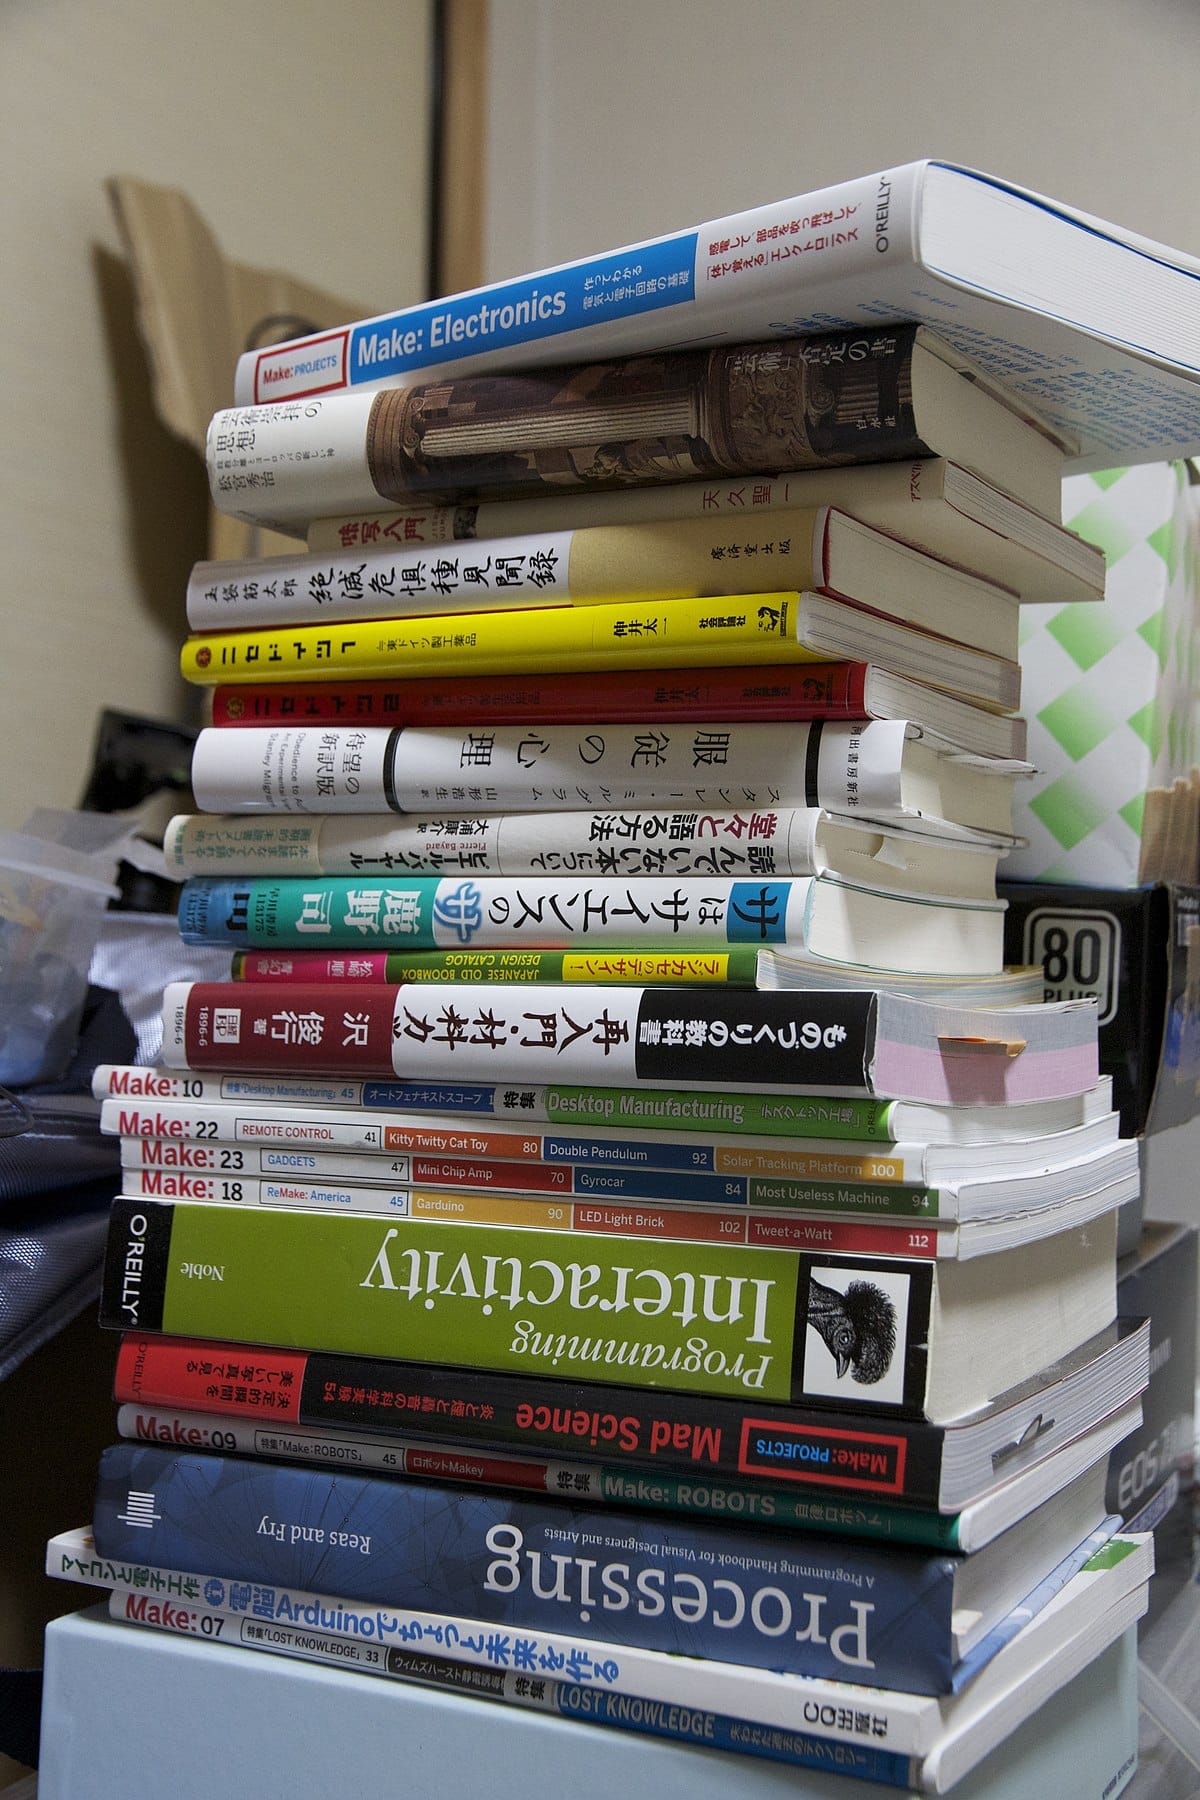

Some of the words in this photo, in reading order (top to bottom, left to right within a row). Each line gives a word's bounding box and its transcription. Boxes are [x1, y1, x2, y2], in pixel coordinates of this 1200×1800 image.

[876, 177, 892, 253] O'REILLY
[707, 228, 858, 280] 「体で覚える」エレクトロニクス
[583, 265, 643, 291] 作ってわかる
[583, 269, 690, 310] 電気と電子回路の基礎
[358, 336, 424, 367] Make:
[430, 290, 567, 347] Electronics
[856, 415, 897, 431] 白水社
[216, 429, 256, 453] 思想
[702, 483, 789, 509] 天久聖一
[338, 517, 427, 547] 味写入門
[308, 548, 560, 604] 絶滅危惧種見聞録
[460, 729, 732, 770] 服従の心理
[316, 732, 341, 797] 新訳版
[342, 732, 363, 795] 待望の
[846, 725, 865, 808] 河出書房新社
[531, 785, 781, 804] スタンレー・ミルグラム
[589, 813, 778, 841] 堂々と語る方法
[425, 841, 457, 851] Bayard
[459, 842, 487, 851] Pierre
[349, 851, 491, 870] ピエール・バイヤール
[530, 846, 776, 875] 読んでいない本について
[296, 889, 422, 935] 鹿野司
[445, 955, 495, 966] CATALOG
[501, 955, 541, 966] DESIGN
[1043, 927, 1101, 985] 80
[401, 968, 455, 981] BOOMBOX
[461, 968, 483, 980] OLD
[489, 969, 540, 981] JAPANESE
[569, 958, 720, 977] ラジカセのデザイン!
[174, 1005, 184, 1045] 1896-6
[199, 1005, 209, 1047] 1896-6
[640, 1018, 849, 1050] ものづくりの教科書
[183, 1080, 203, 1098] 10
[341, 1089, 354, 1099] 45
[503, 1090, 536, 1109] 特集
[620, 1096, 744, 1125] Manufacturing
[118, 1111, 191, 1138] Make:
[196, 1121, 219, 1140] 22
[242, 1124, 282, 1137] REMOTE
[285, 1127, 335, 1140] CONTROL
[364, 1132, 377, 1143] 41
[389, 1132, 414, 1147] Kitty
[416, 1134, 448, 1150] Twitty
[449, 1137, 468, 1150] Cat
[469, 1138, 488, 1152] Toy
[522, 1142, 538, 1153] 80
[220, 1151, 244, 1169] 23
[267, 1154, 316, 1168] GADGETS
[391, 1162, 404, 1173] 47
[549, 1144, 589, 1158] Double
[591, 1146, 648, 1161] Pendulum
[692, 1152, 707, 1165] 92
[722, 1154, 753, 1167] Solar
[756, 1157, 805, 1173] Tracking
[808, 1161, 863, 1176] Platform
[871, 1165, 895, 1177] 100
[417, 1163, 440, 1176] Mini
[441, 1165, 466, 1180] Chip
[467, 1167, 493, 1181] Amp
[551, 1172, 565, 1184] 70
[580, 1174, 625, 1189] Gyrocar
[725, 1183, 741, 1195] 84
[221, 1183, 243, 1201] 18
[267, 1187, 308, 1200] ReMake:
[310, 1190, 351, 1203] America
[389, 1196, 404, 1207] 45
[756, 1185, 787, 1199] Most
[796, 1188, 836, 1202] Useless
[838, 1191, 890, 1205] Machine
[912, 1195, 930, 1207] 94
[416, 1199, 465, 1212] Garduino
[548, 1208, 563, 1219] 90
[579, 1211, 602, 1223] LED
[604, 1213, 633, 1227] Light
[635, 1215, 665, 1228] Brick
[719, 1221, 740, 1233] 102
[755, 1223, 832, 1240] Tweet-a-Watt
[908, 1235, 929, 1247] 112
[121, 1214, 148, 1325] O'REILLY
[180, 1262, 225, 1282] Noble
[359, 1228, 776, 1344] Interactivity
[508, 1319, 774, 1389] Programming
[186, 1360, 294, 1387] 美しい写真で見る
[205, 1384, 290, 1409] 決定的瞬間を
[515, 1404, 639, 1450] Science
[649, 1419, 721, 1462] Mad
[382, 1453, 396, 1465] 45
[413, 1457, 484, 1478] ロボットMakey
[557, 1470, 591, 1492] 特集
[677, 1486, 777, 1516] ROBOTS
[256, 1515, 286, 1542] Fry
[290, 1525, 324, 1544] and
[543, 1527, 580, 1544] Artists
[581, 1533, 602, 1545] and
[330, 1530, 371, 1554] Reas
[602, 1536, 658, 1556] Designers
[661, 1543, 697, 1561] Visual
[699, 1549, 715, 1563] for
[717, 1551, 778, 1573] Handbook
[61, 1554, 201, 1600] マイコンと電子工作
[780, 1559, 863, 1587] Programming
[866, 1575, 875, 1589] A
[483, 1523, 875, 1669] Processing
[200, 1615, 224, 1637] 07
[365, 1650, 379, 1663] 33
[514, 1677, 546, 1700] 特集
[606, 1694, 715, 1740] KNOWLEDGE
[802, 1701, 889, 1738] CQ出版社
